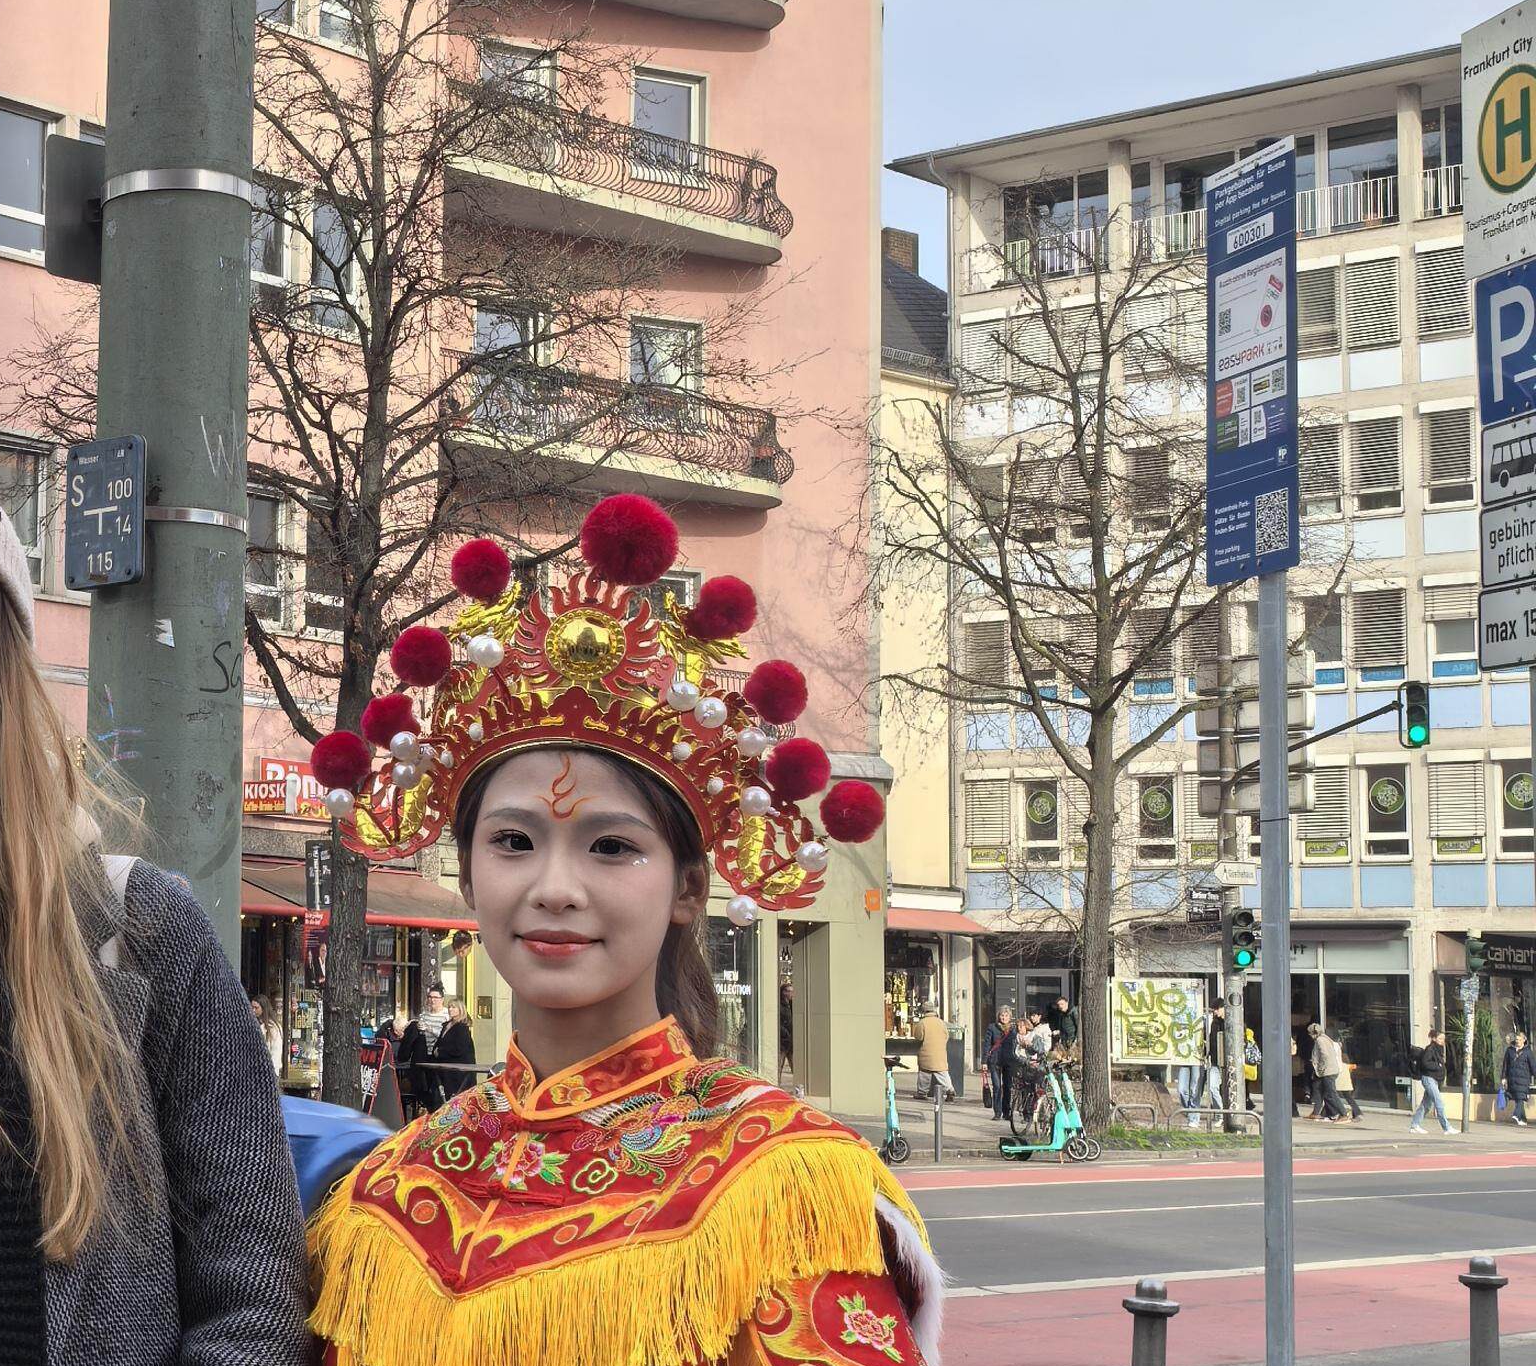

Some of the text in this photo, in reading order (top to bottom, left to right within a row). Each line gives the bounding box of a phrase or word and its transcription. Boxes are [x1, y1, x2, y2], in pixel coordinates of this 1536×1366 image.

[1463, 37, 1533, 80] Frankfurt City
[1465, 195, 1536, 231] Tourismus+Congre
[1233, 223, 1266, 249] 600301
[1482, 218, 1515, 240] Frankfurt
[1490, 285, 1535, 402] P
[70, 474, 133, 507] S 100
[1498, 542, 1536, 574] pflich
[1486, 619, 1517, 644] max
[244, 783, 286, 800] KIOSK
[723, 970, 739, 982] NEW
[714, 983, 751, 996] OLLECTION
